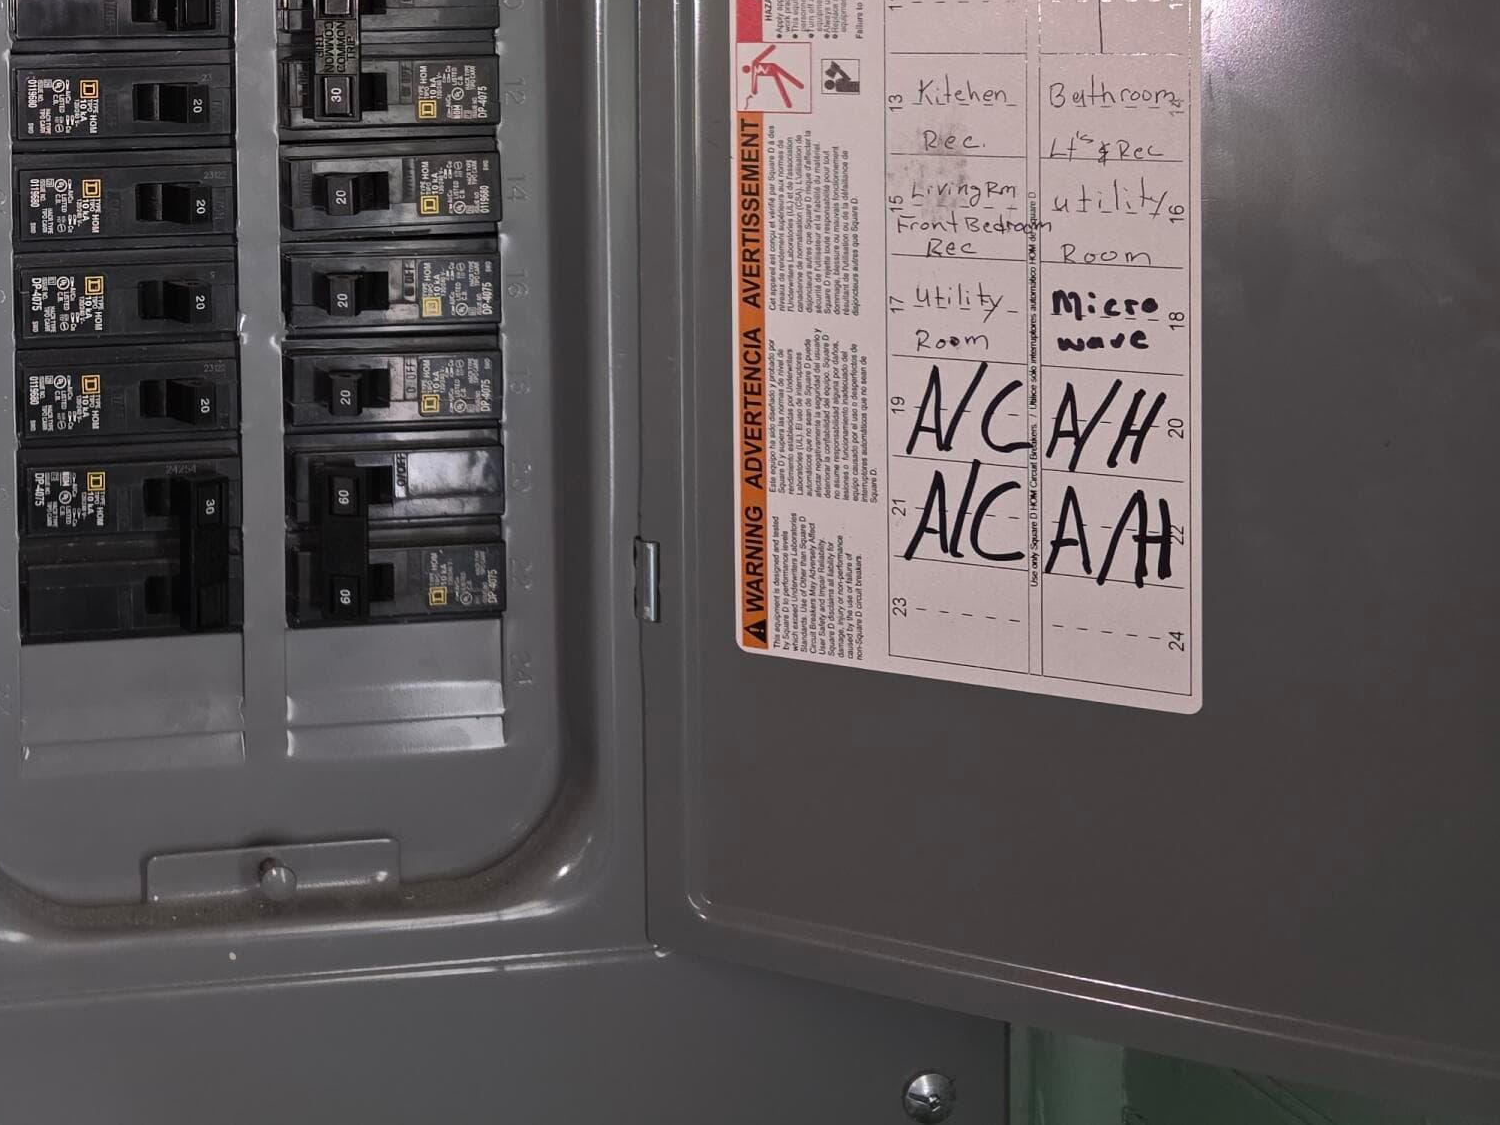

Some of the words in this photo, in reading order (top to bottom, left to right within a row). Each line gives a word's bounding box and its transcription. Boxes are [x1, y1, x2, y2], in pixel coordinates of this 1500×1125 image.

[419, 65, 428, 84] HOM
[28, 79, 37, 108] 0119680
[331, 88, 342, 103] 30
[919, 74, 1006, 105] Kitchen
[1050, 74, 1176, 108] Bathroom
[193, 99, 202, 113] 20
[477, 85, 488, 118] DP-4075
[889, 94, 903, 112] 13
[1119, 139, 1163, 157] Rec
[336, 190, 347, 204] 20
[479, 185, 490, 213] 0119680
[889, 195, 903, 212] 15
[912, 182, 981, 206] Living
[987, 182, 1016, 197] Rm
[196, 199, 205, 214] 20
[740, 118, 762, 309] AVERTISSEMENT
[1169, 205, 1185, 224] 16
[897, 211, 958, 233] Front
[965, 214, 1052, 234] Bedroom
[926, 238, 977, 257] Rec
[1061, 243, 1151, 265] Room
[31, 278, 42, 310] DP-4075
[196, 295, 205, 309] 20
[337, 293, 349, 309] 20
[889, 296, 904, 312] 17
[1052, 290, 1158, 320] Micro
[1169, 312, 1185, 331] 18
[916, 330, 988, 351] Room
[1057, 331, 1149, 351] wave
[339, 390, 351, 405] 20
[480, 378, 492, 412] DP-4075
[201, 398, 210, 413] 20
[743, 328, 762, 490] ADVERTENCIA
[891, 397, 905, 414] 19
[906, 361, 1033, 454] A/C
[1046, 379, 1166, 472] A/H
[1168, 418, 1184, 439] 20
[206, 499, 215, 514] 30
[337, 489, 350, 505] 60
[891, 498, 906, 517] 21
[904, 459, 1025, 560] A/C
[1044, 486, 1172, 588] A/H
[744, 506, 764, 612] WARNING
[339, 588, 351, 605] 60
[892, 597, 907, 617] 23
[1168, 631, 1185, 652] 24
